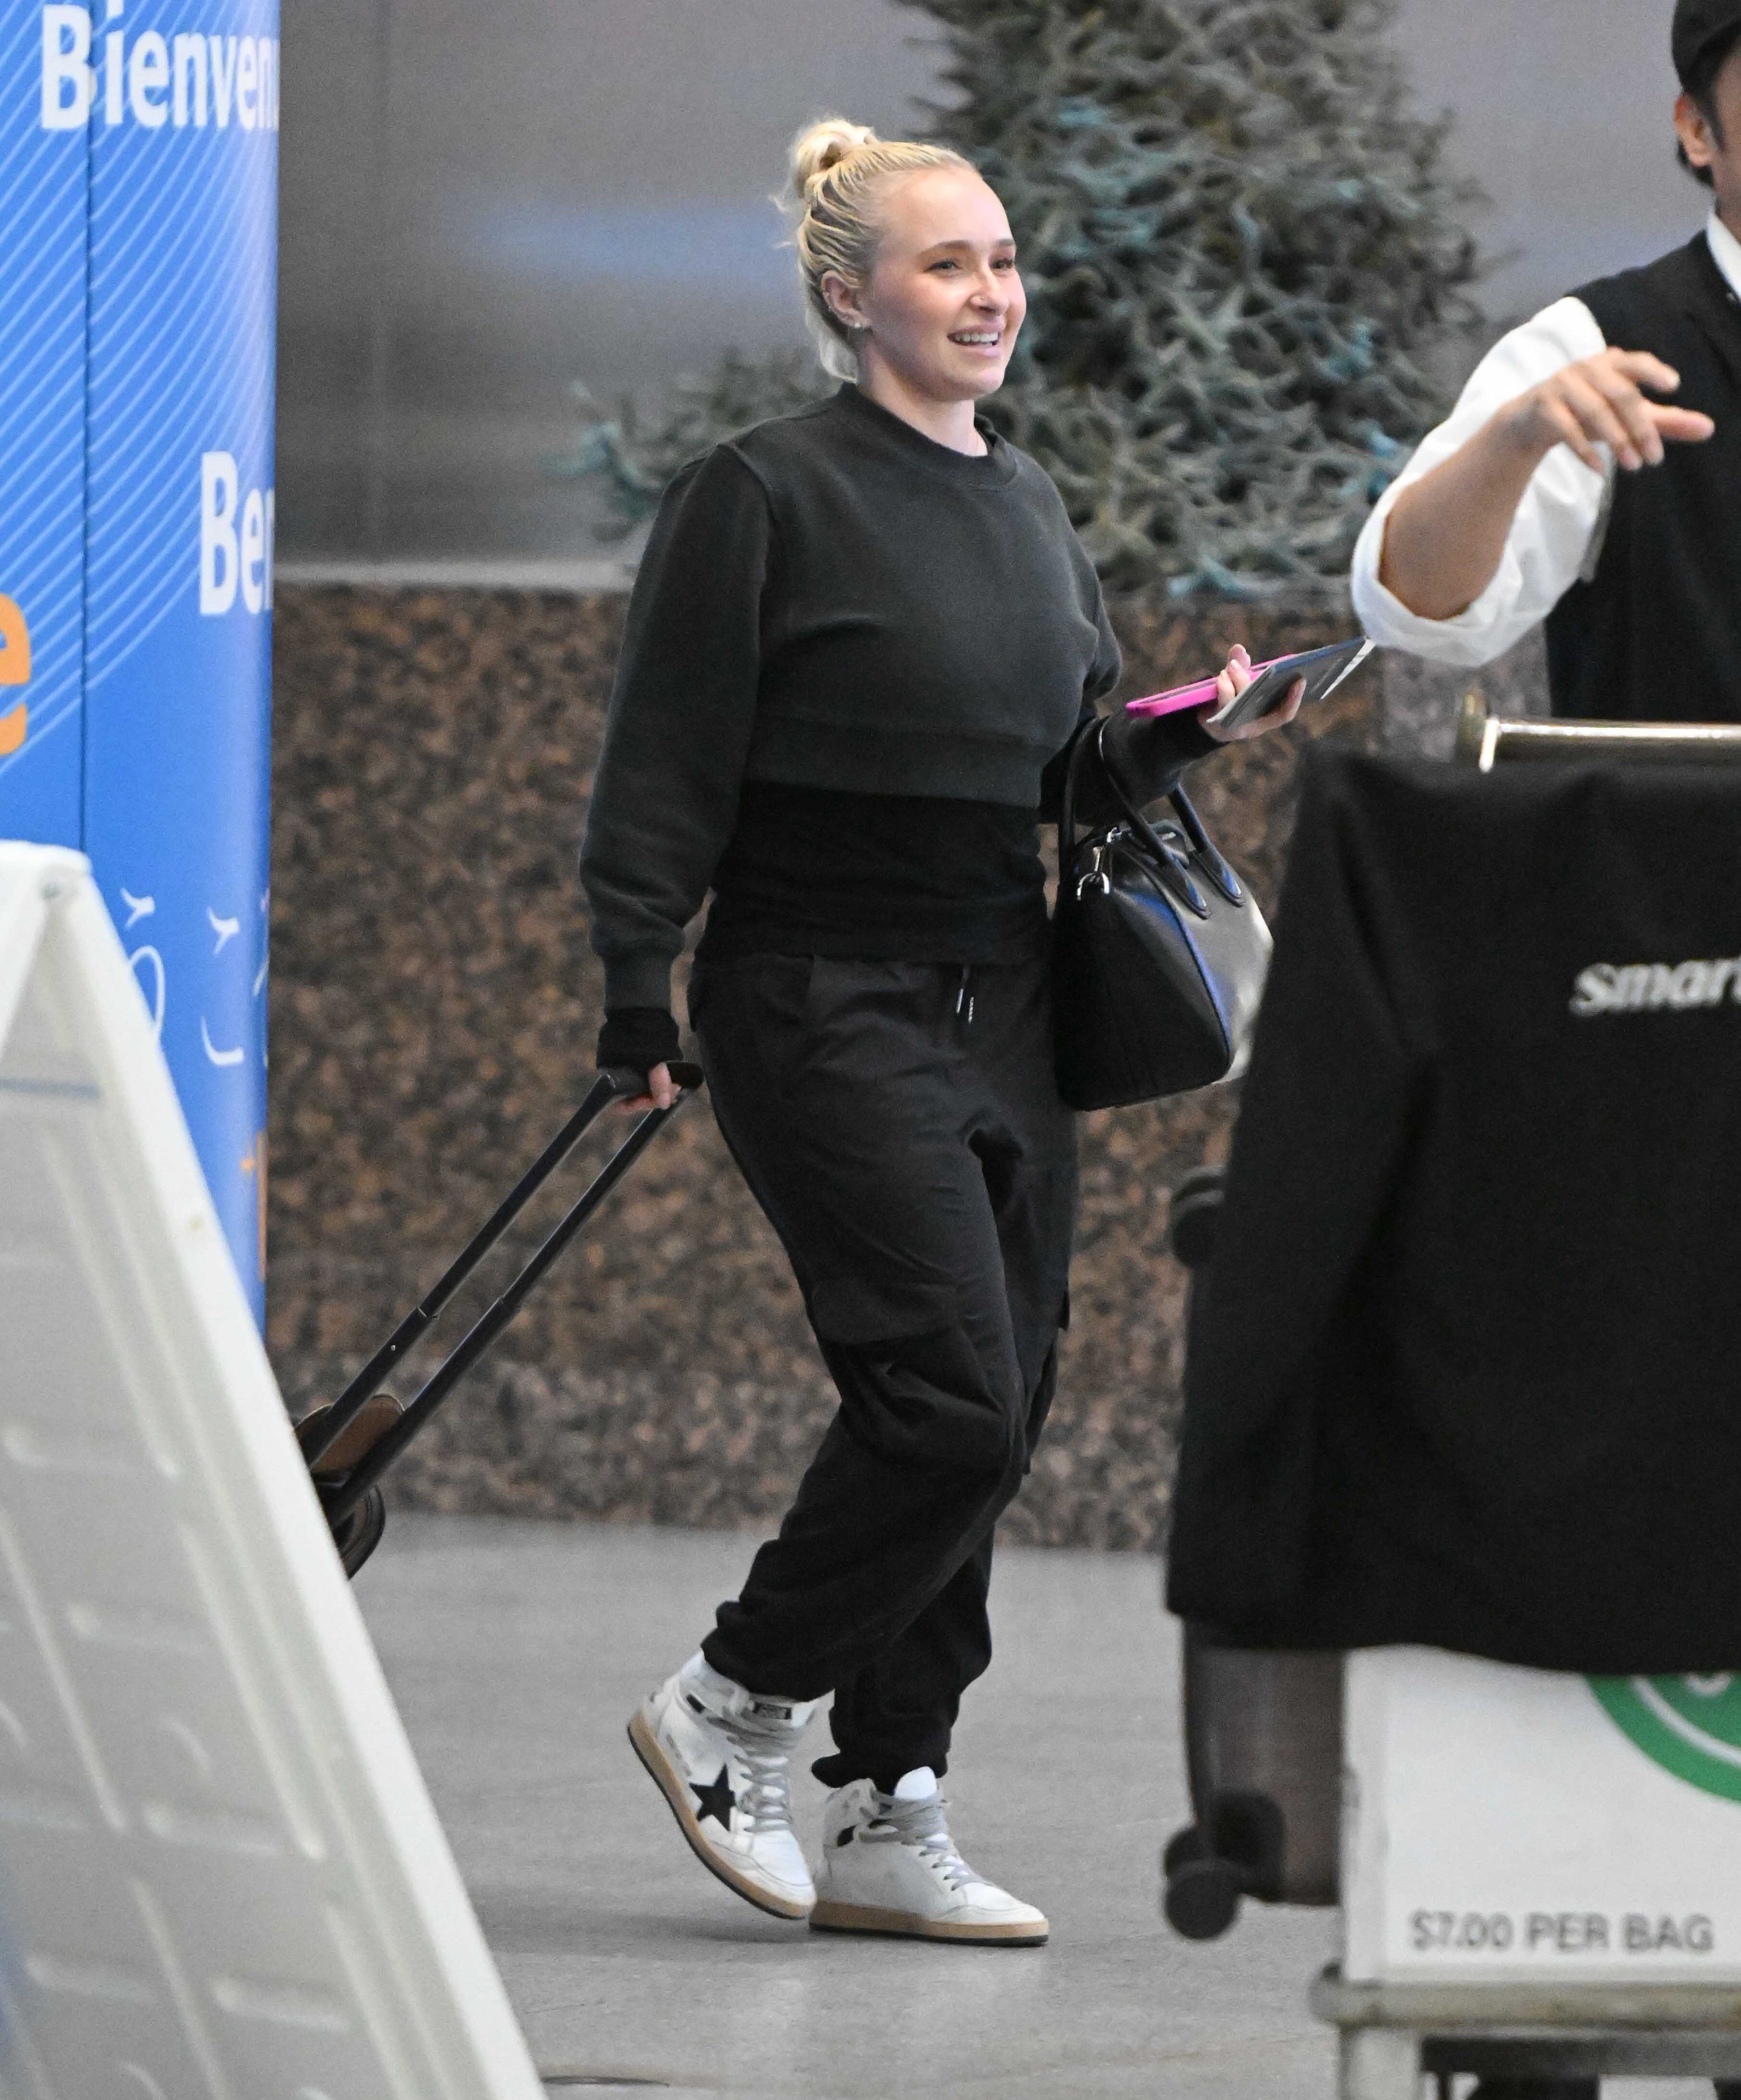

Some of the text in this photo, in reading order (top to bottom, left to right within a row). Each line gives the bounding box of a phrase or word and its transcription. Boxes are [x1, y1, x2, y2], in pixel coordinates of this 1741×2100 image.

[41, 0, 279, 131] Bienven
[1409, 1908, 1714, 1952] $7.00 PER BAG
